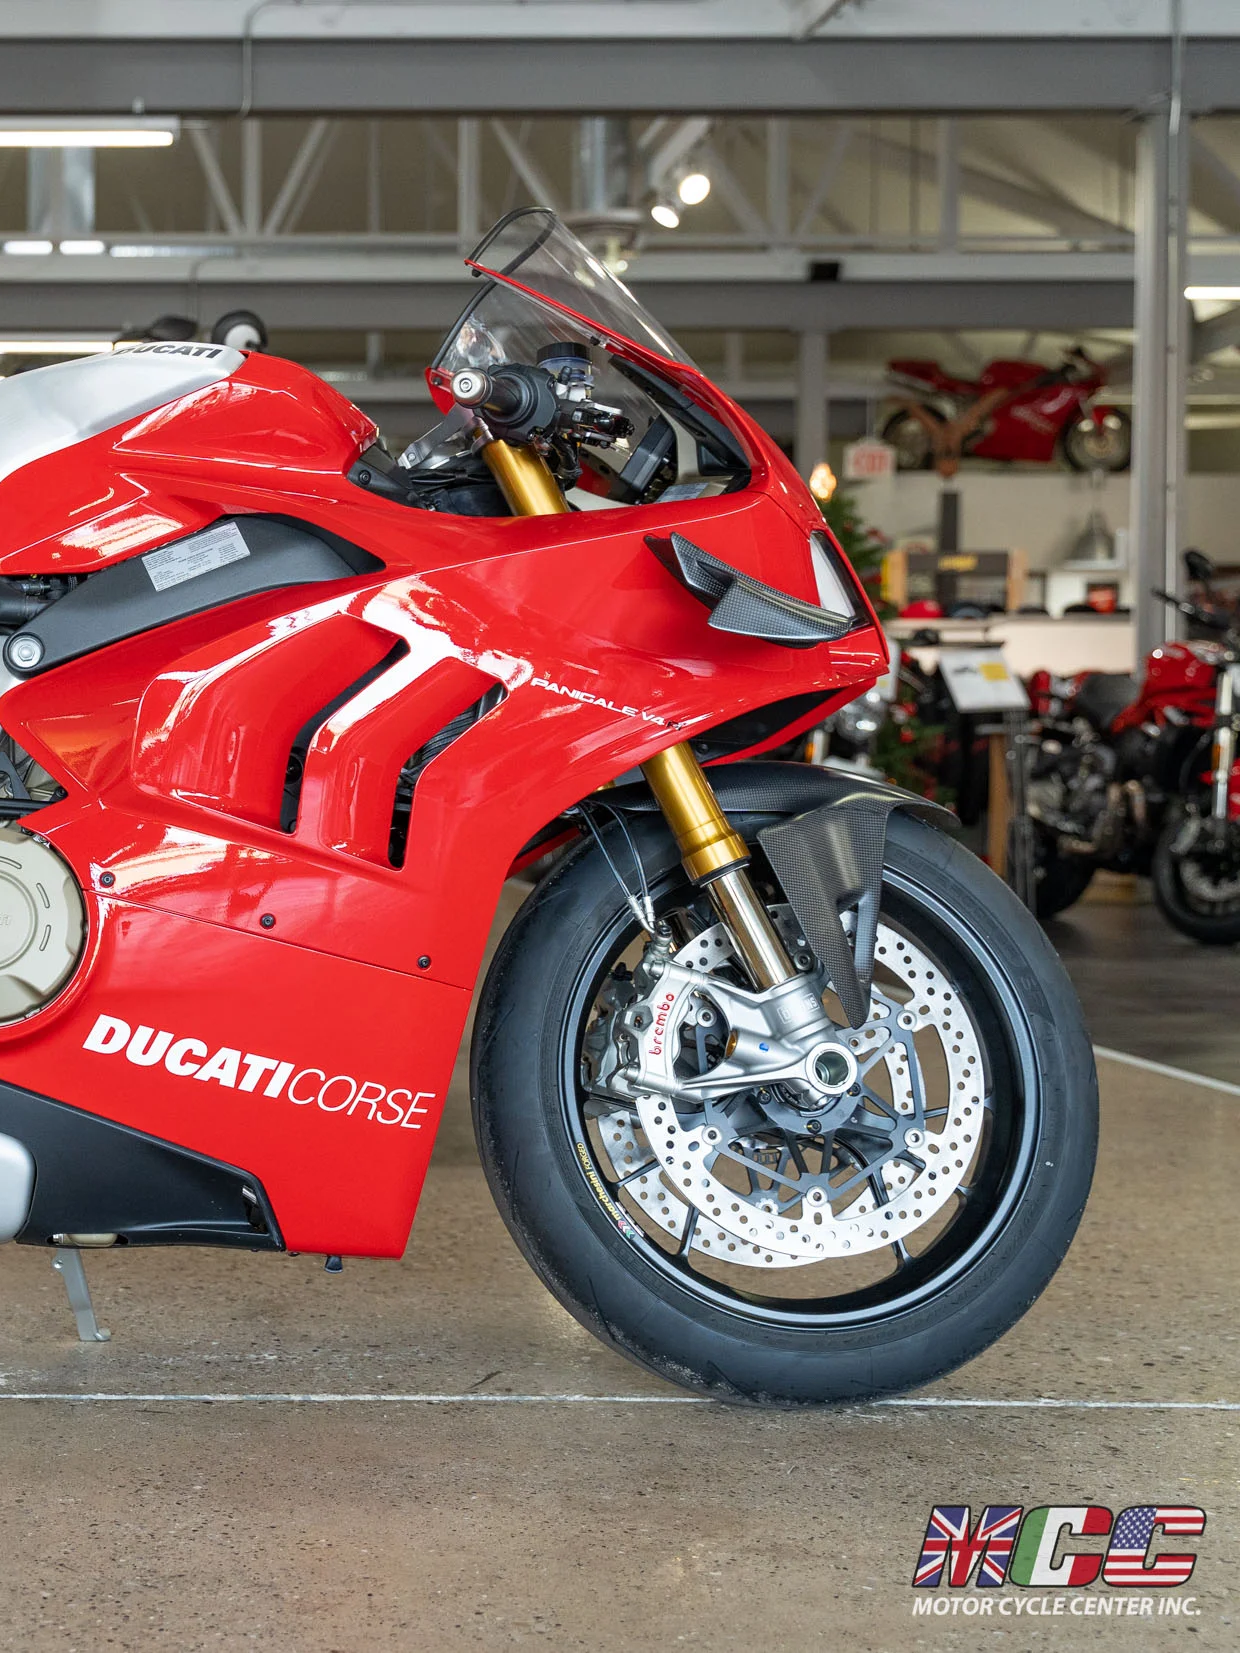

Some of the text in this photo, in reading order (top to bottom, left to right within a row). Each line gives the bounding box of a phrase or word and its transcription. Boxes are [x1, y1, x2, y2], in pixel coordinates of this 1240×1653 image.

[111, 344, 224, 359] DUCATI
[530, 677, 639, 717] PANIGALE
[641, 711, 665, 726] V4
[648, 993, 675, 1056] brembo
[586, 1170, 622, 1221] marchesini
